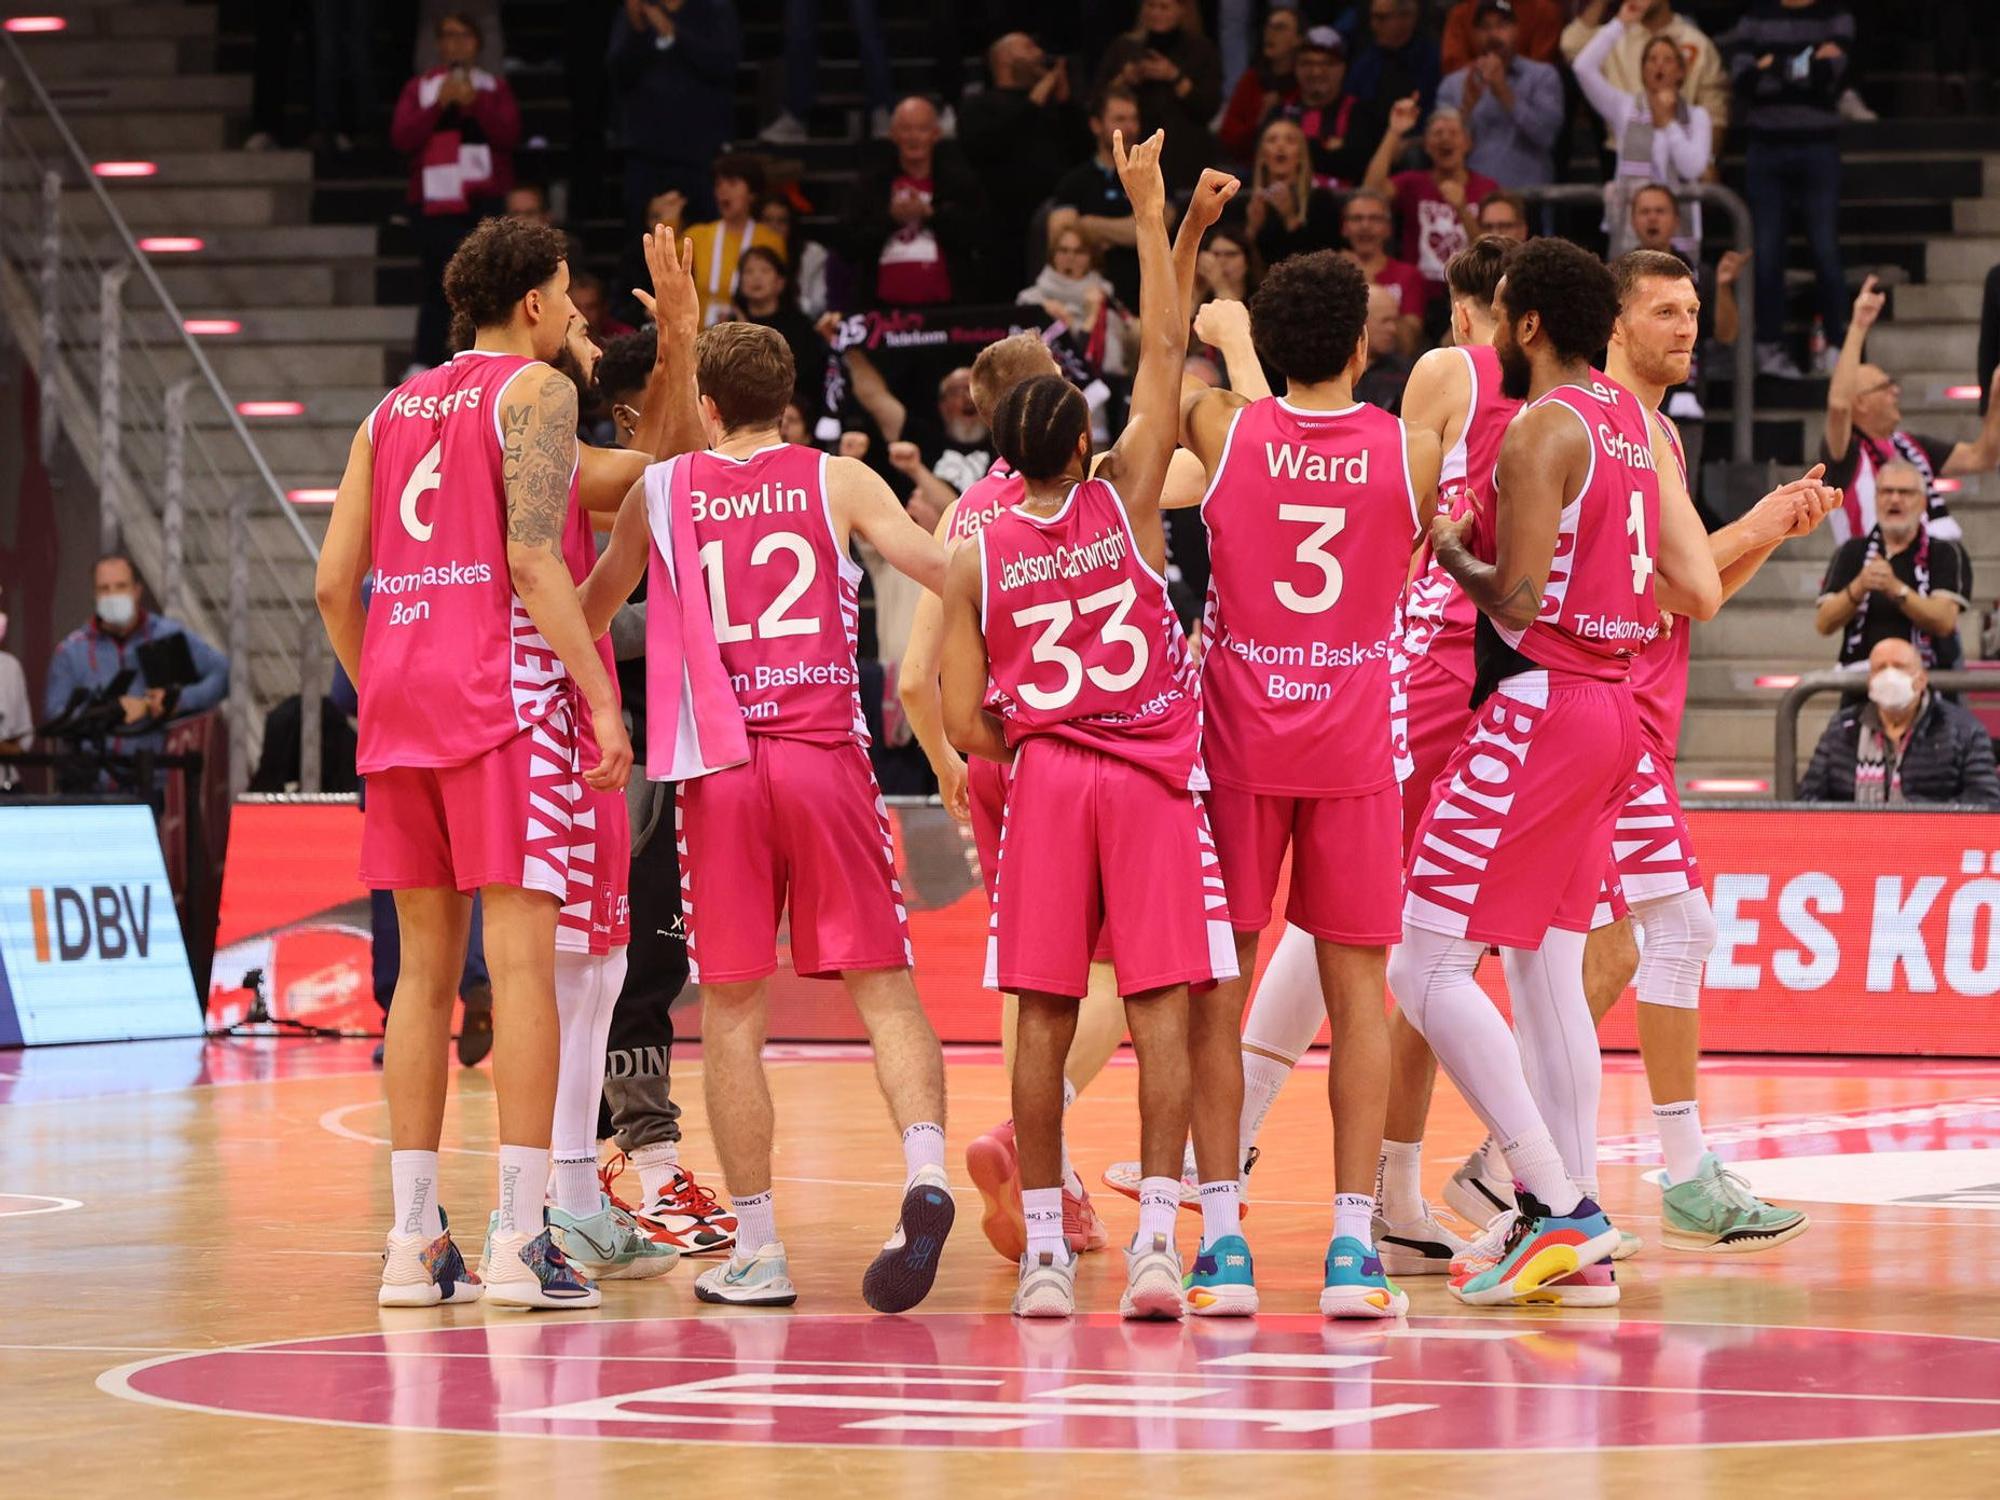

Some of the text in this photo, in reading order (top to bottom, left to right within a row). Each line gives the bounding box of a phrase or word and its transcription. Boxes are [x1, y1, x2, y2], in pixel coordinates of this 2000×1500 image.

[399, 439, 442, 542] 6
[1265, 442, 1369, 485] Ward
[690, 482, 808, 522] Bowlin
[422, 558, 492, 586] askets
[698, 531, 822, 644] 12
[999, 525, 1127, 592] Jackson-Cartwright
[1273, 503, 1346, 614] 3
[755, 661, 851, 691] Baskets
[1012, 578, 1149, 710] 33
[1267, 674, 1332, 701] Bonn
[54, 884, 151, 962] DBV
[405, 1176, 432, 1235] SPALDING
[500, 1165, 521, 1232] SPALDING
